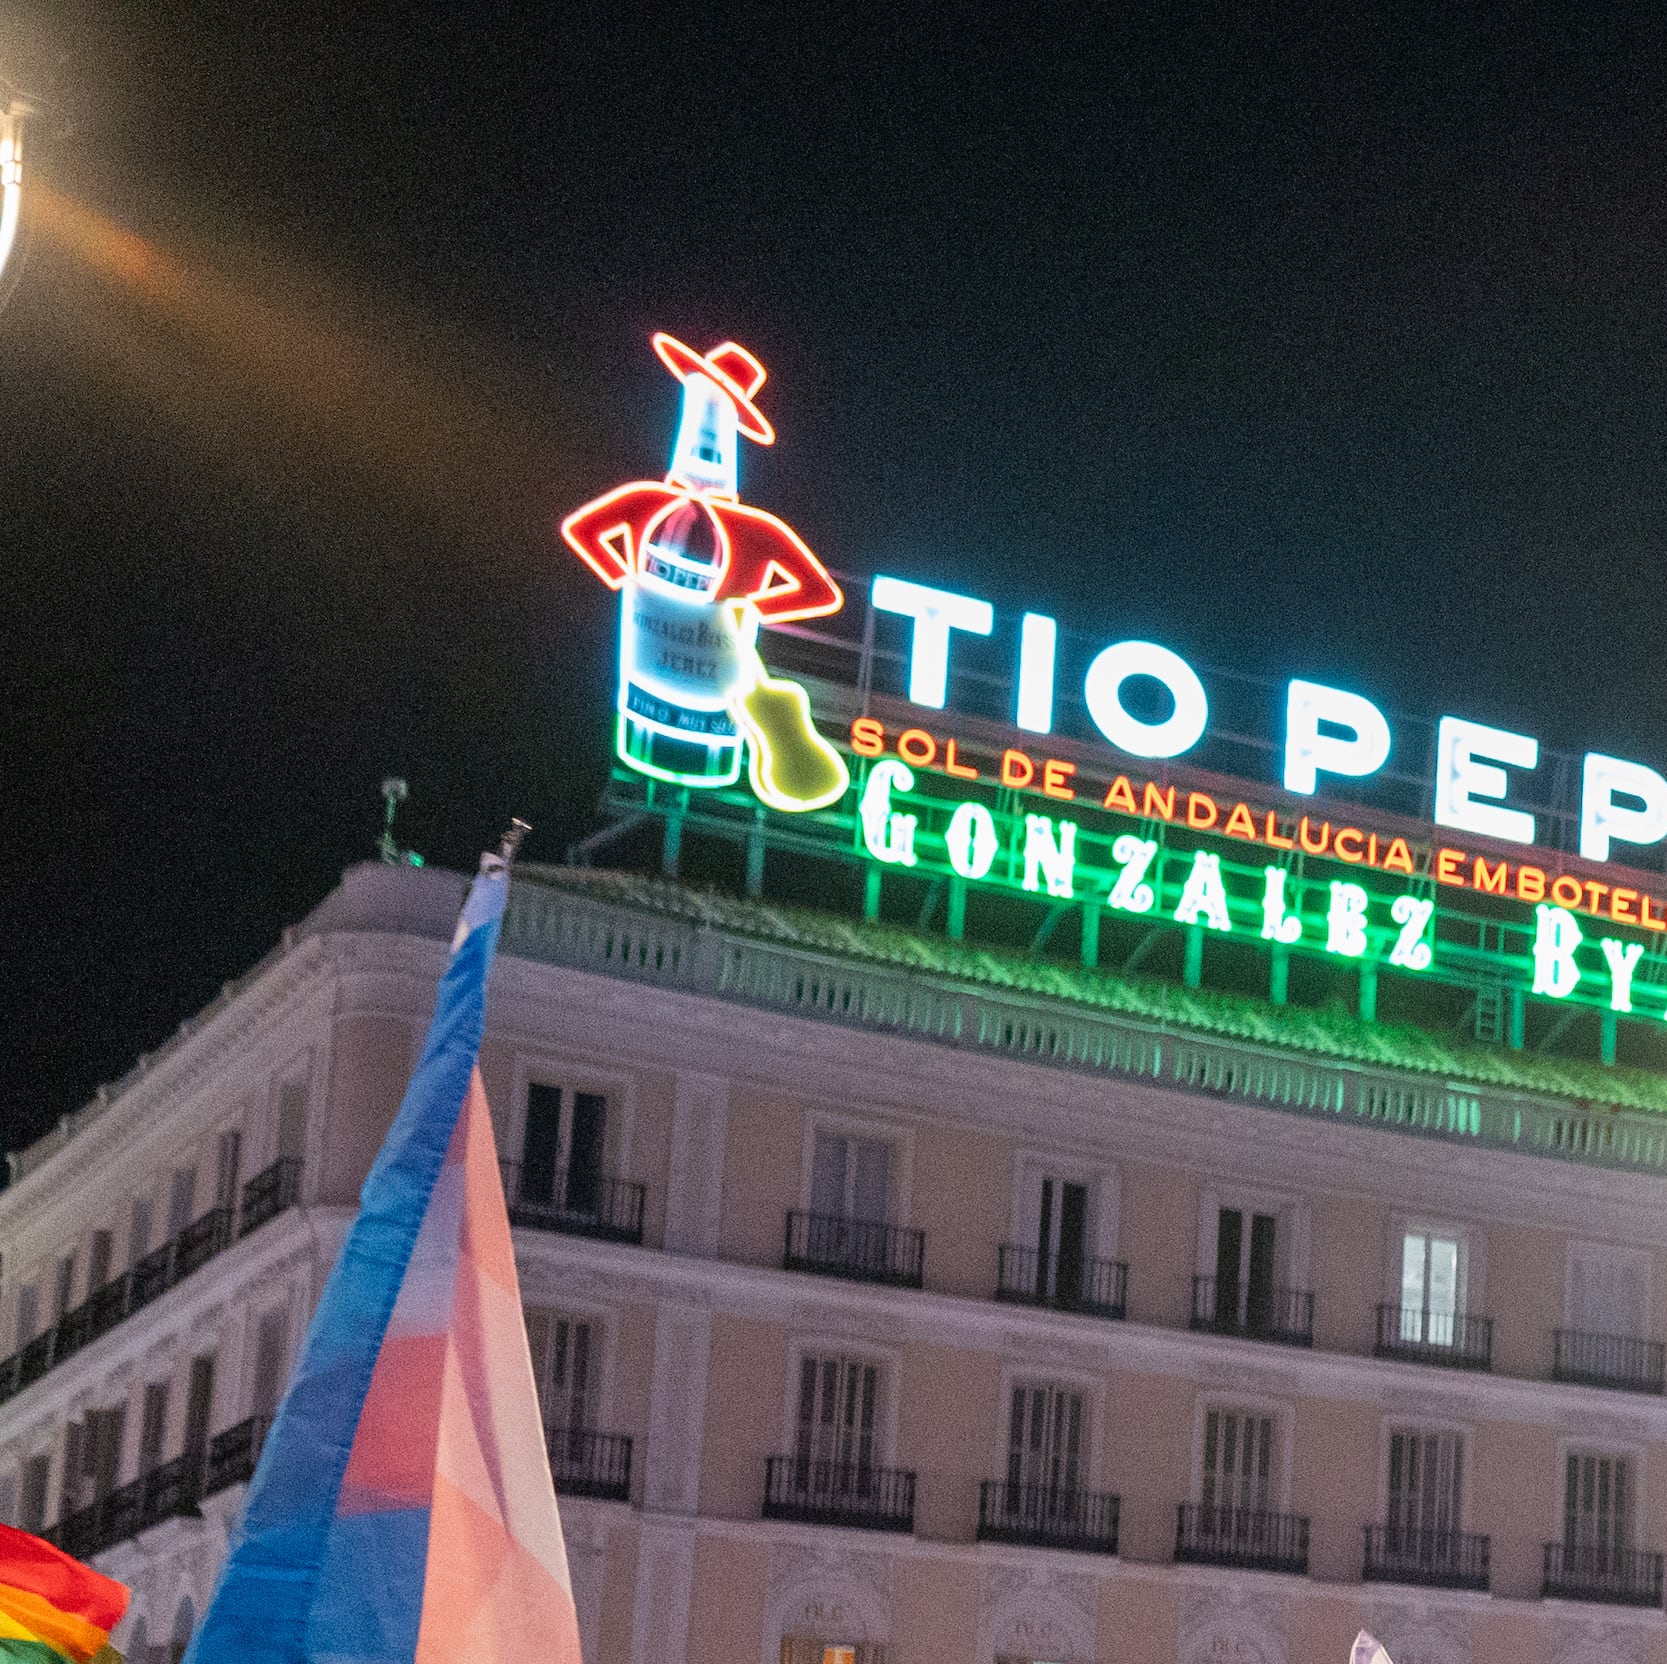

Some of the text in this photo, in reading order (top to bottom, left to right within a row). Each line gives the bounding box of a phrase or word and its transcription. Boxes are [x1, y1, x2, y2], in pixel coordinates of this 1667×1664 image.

[872, 574, 1208, 759] TIO
[851, 717, 979, 779] SOL
[1002, 748, 1077, 801] DE
[1103, 774, 1414, 875] ANDALUCIA
[858, 758, 1437, 972] GONZALEZ
